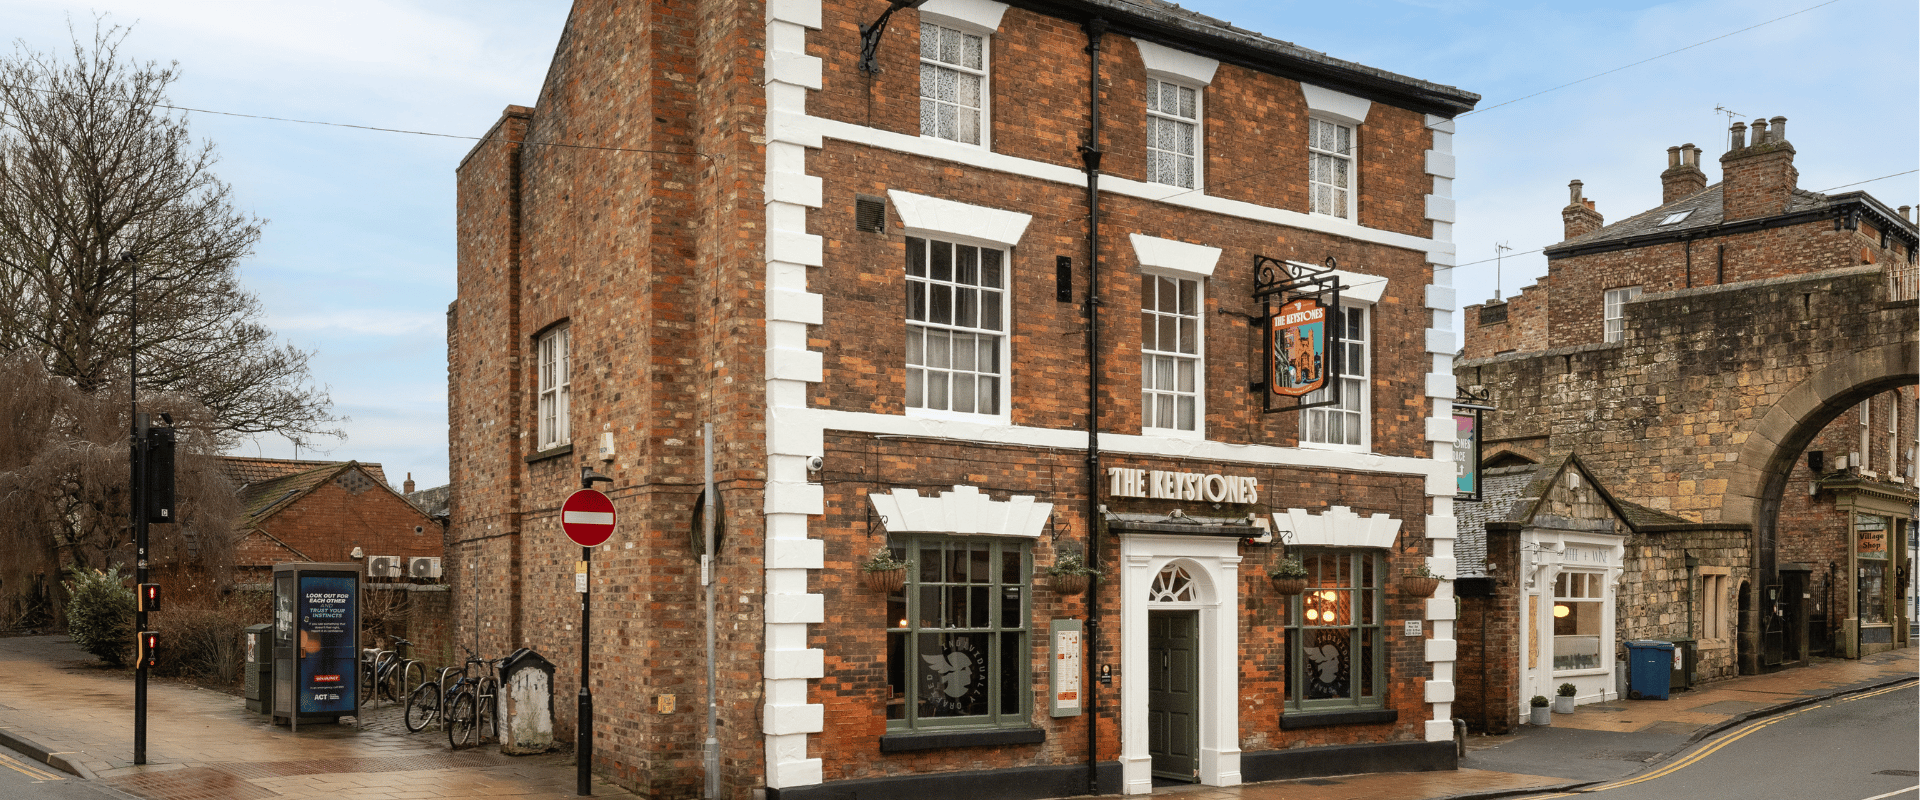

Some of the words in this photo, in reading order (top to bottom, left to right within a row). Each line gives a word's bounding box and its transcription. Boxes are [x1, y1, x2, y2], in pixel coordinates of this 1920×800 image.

[1274, 315, 1286, 327] THE
[1286, 308, 1323, 325] KEYSTONES
[1108, 467, 1146, 498] THE
[1149, 470, 1258, 504] KEYSTONES
[1859, 532, 1885, 541] Village
[1862, 541, 1881, 550] Shop
[1593, 549, 1608, 563] WINE
[941, 640, 986, 703] INDIVIDUALLY
